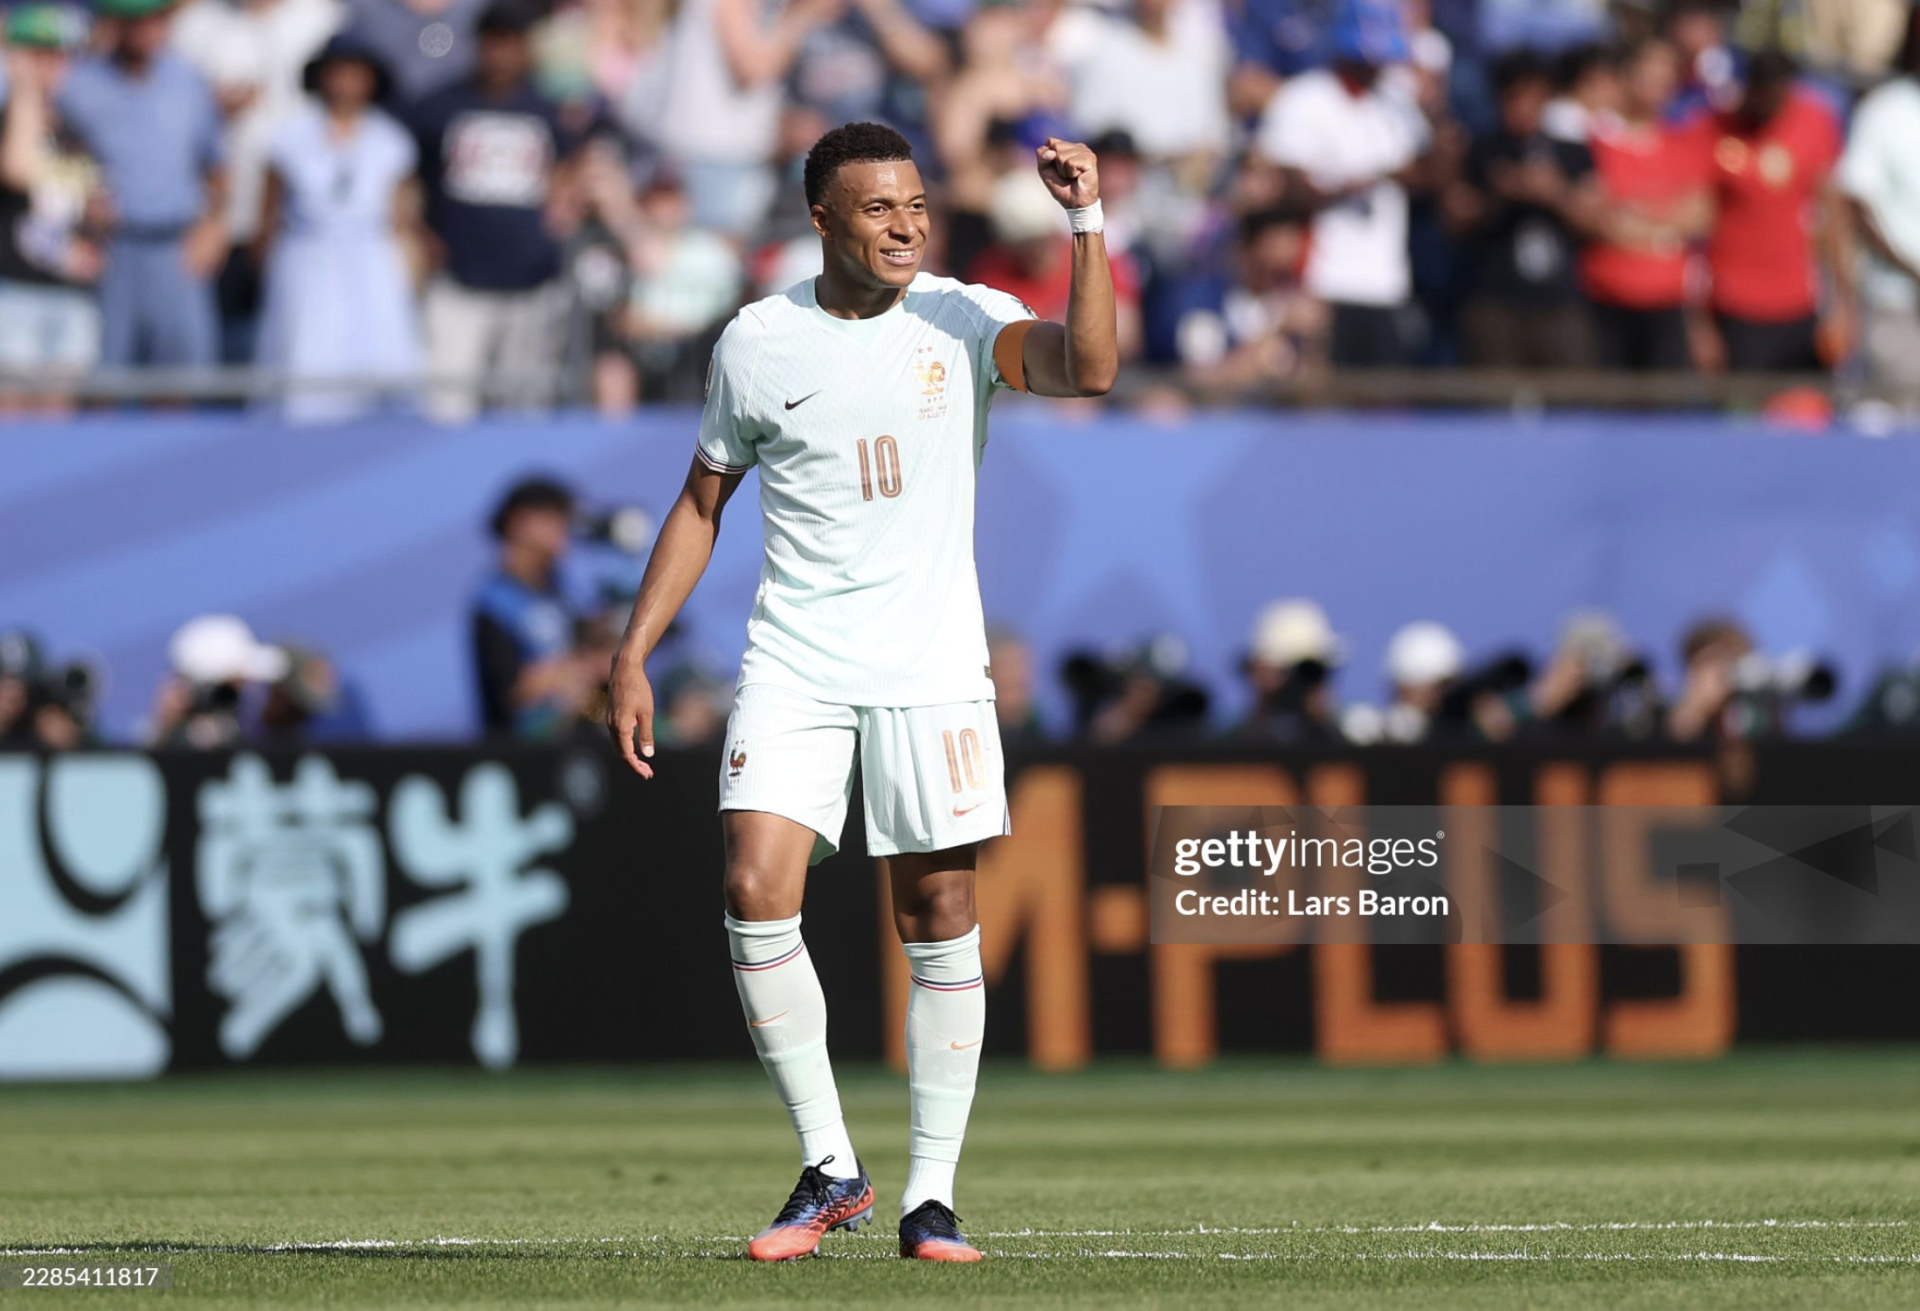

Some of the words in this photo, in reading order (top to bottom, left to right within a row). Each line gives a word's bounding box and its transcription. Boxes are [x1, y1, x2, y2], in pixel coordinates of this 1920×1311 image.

[856, 435, 902, 501] 10
[942, 727, 987, 794] 10
[196, 753, 572, 1068] 蒙牛
